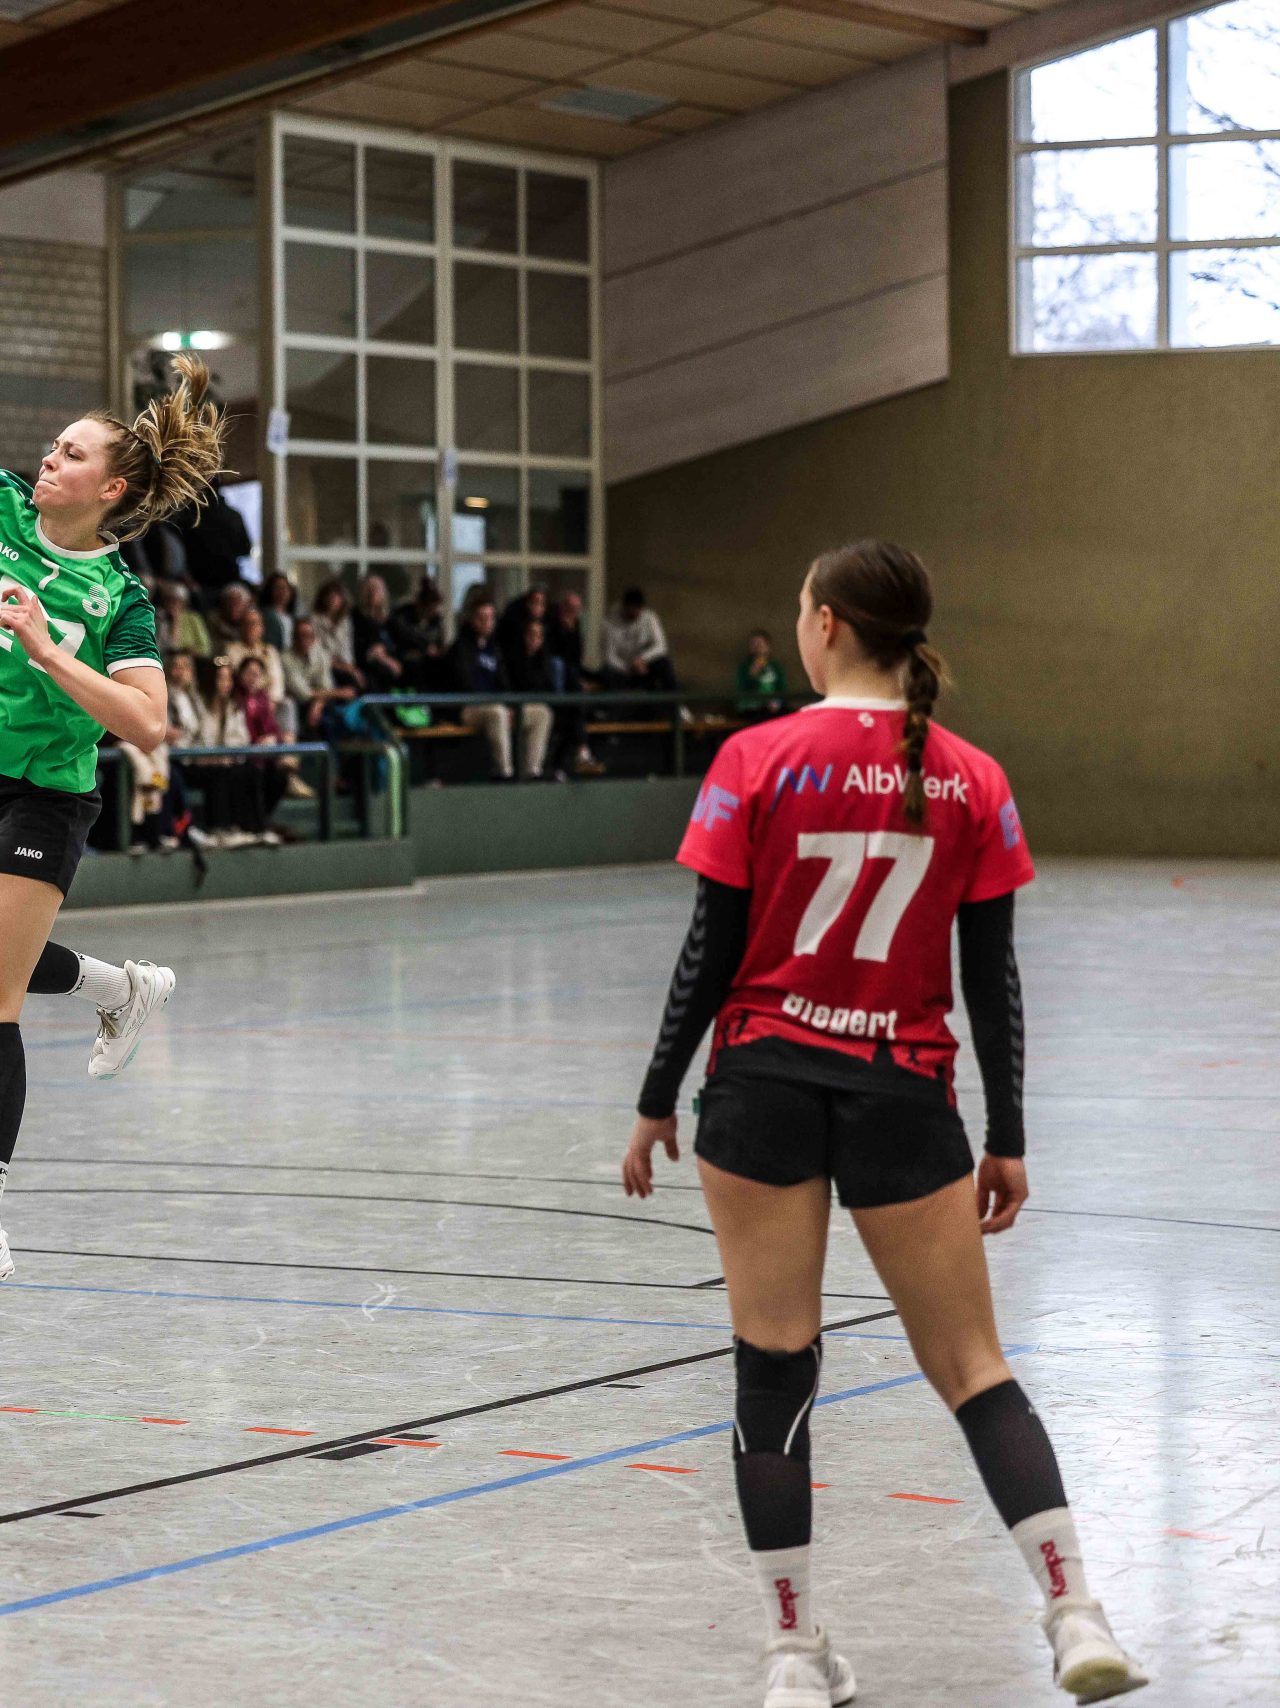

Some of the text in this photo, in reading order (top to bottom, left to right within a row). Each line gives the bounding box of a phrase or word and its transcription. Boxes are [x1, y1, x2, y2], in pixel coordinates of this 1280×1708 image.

[14, 846, 44, 860] JAKO
[792, 830, 935, 963] 77
[1037, 1540, 1070, 1600] Kempa
[773, 1577, 801, 1631] Kempa
